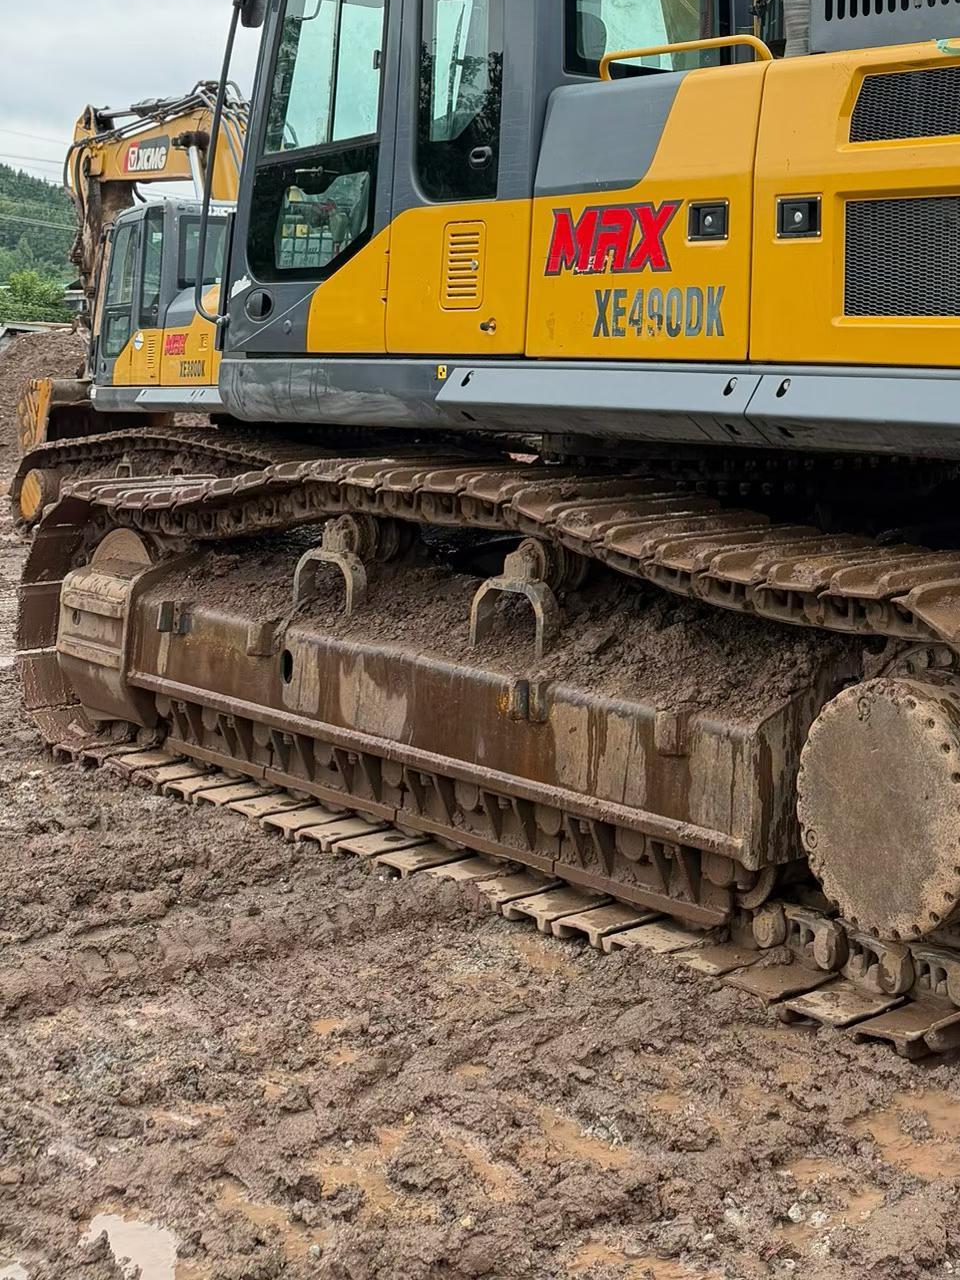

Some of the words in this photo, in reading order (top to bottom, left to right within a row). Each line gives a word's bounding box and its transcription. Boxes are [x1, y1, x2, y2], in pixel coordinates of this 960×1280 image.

[136, 146, 167, 170] XCMG
[544, 199, 685, 276] MAX
[592, 286, 726, 337] XE490DK
